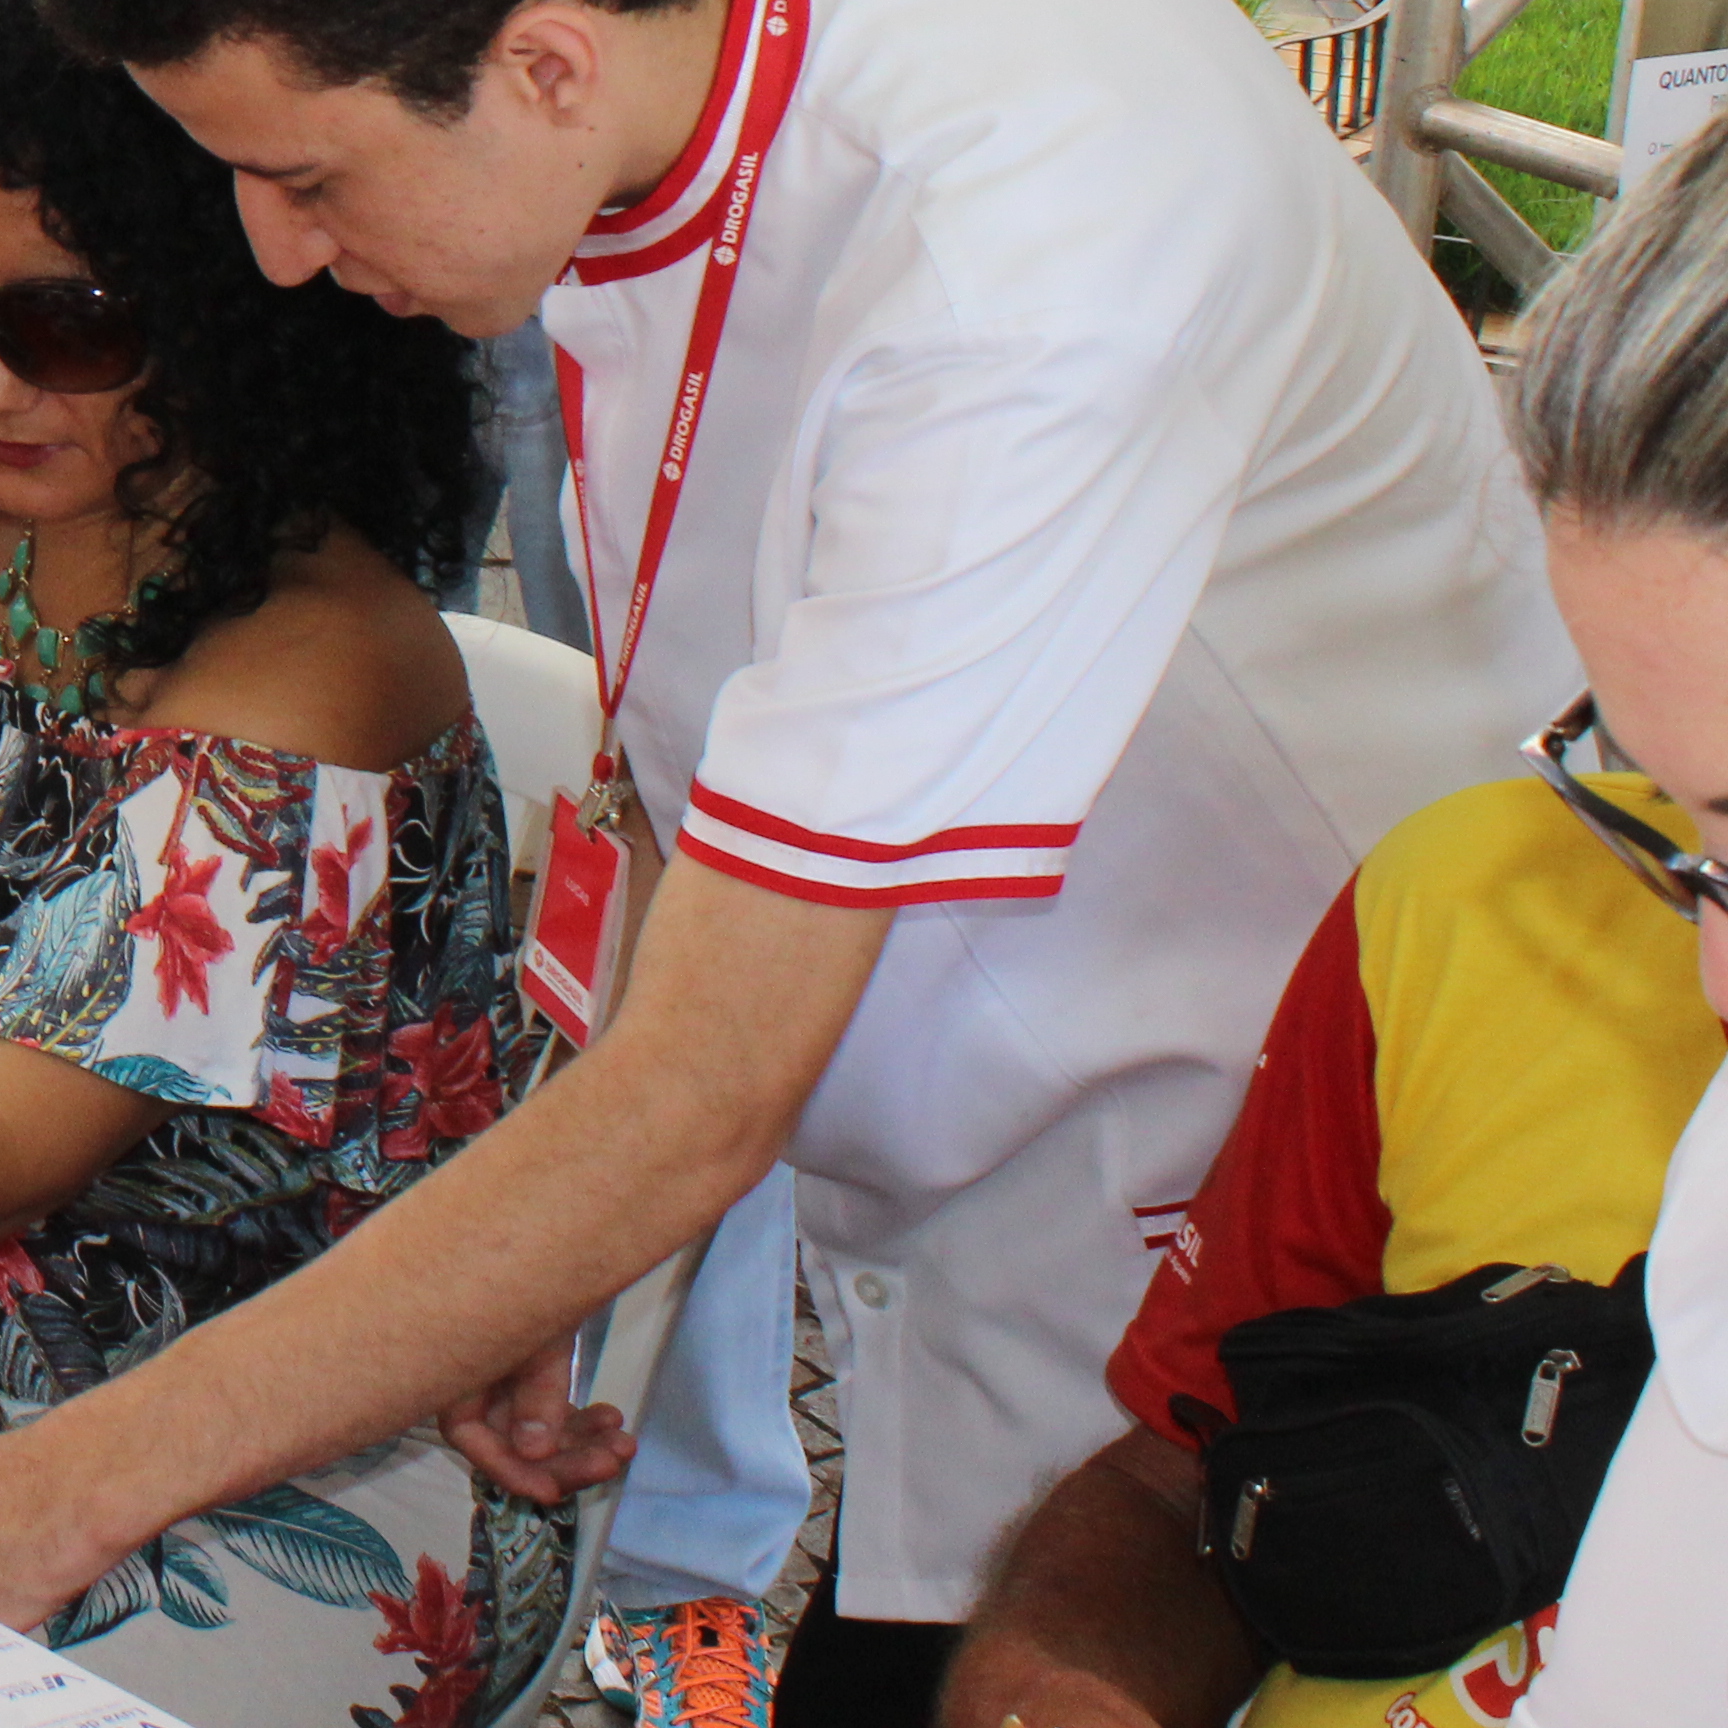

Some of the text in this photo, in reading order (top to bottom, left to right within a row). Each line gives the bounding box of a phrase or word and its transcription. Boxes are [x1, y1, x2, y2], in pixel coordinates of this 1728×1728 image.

[1659, 64, 1728, 89] QUANTO
[721, 152, 759, 244] DROGASIL
[669, 371, 703, 462] DROGASIL
[1176, 1222, 1203, 1268] SIL
